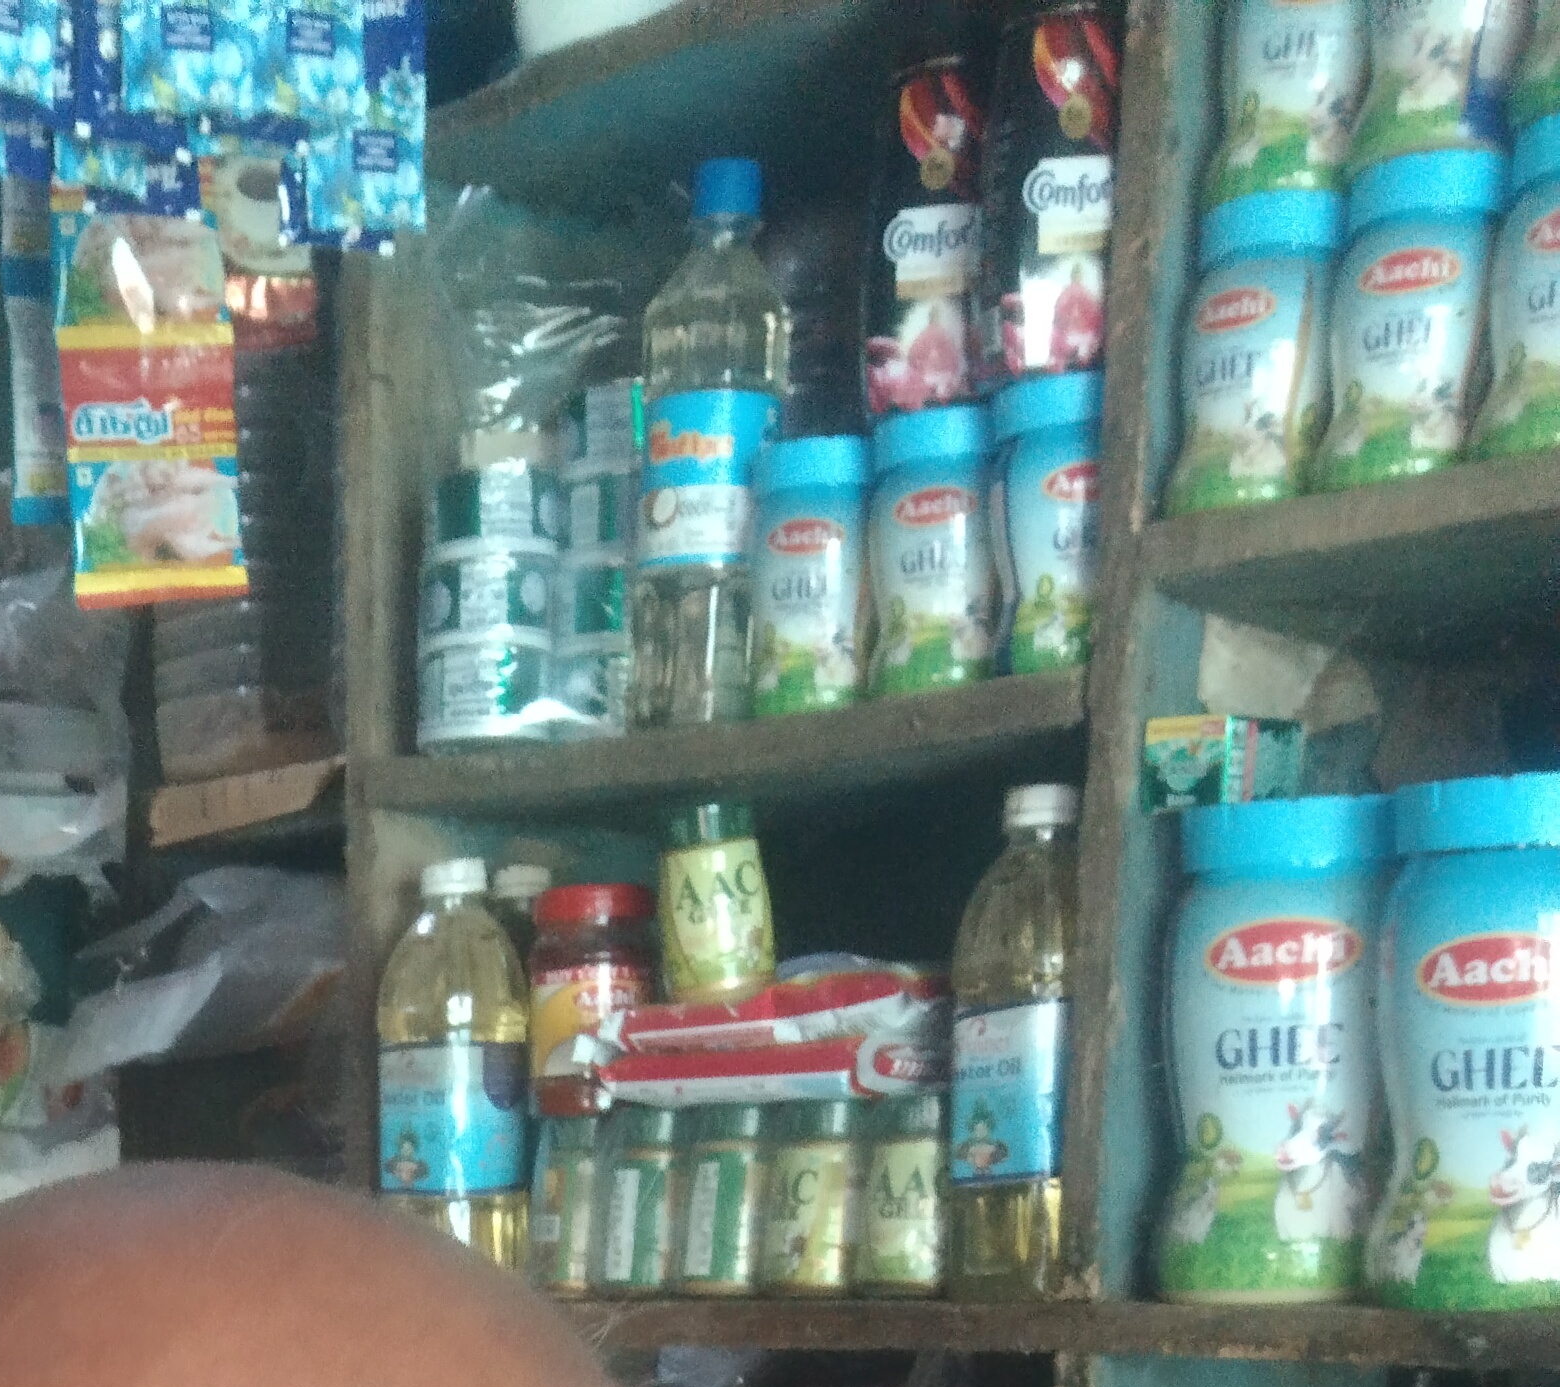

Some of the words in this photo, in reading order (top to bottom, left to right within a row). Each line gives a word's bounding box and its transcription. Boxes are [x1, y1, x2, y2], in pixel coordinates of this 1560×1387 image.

[771, 526, 842, 551] Aach
[1216, 931, 1346, 972] Aachi
[1429, 948, 1554, 989] Aach
[578, 987, 637, 1008] Ahi
[1215, 1023, 1345, 1071] GHEE
